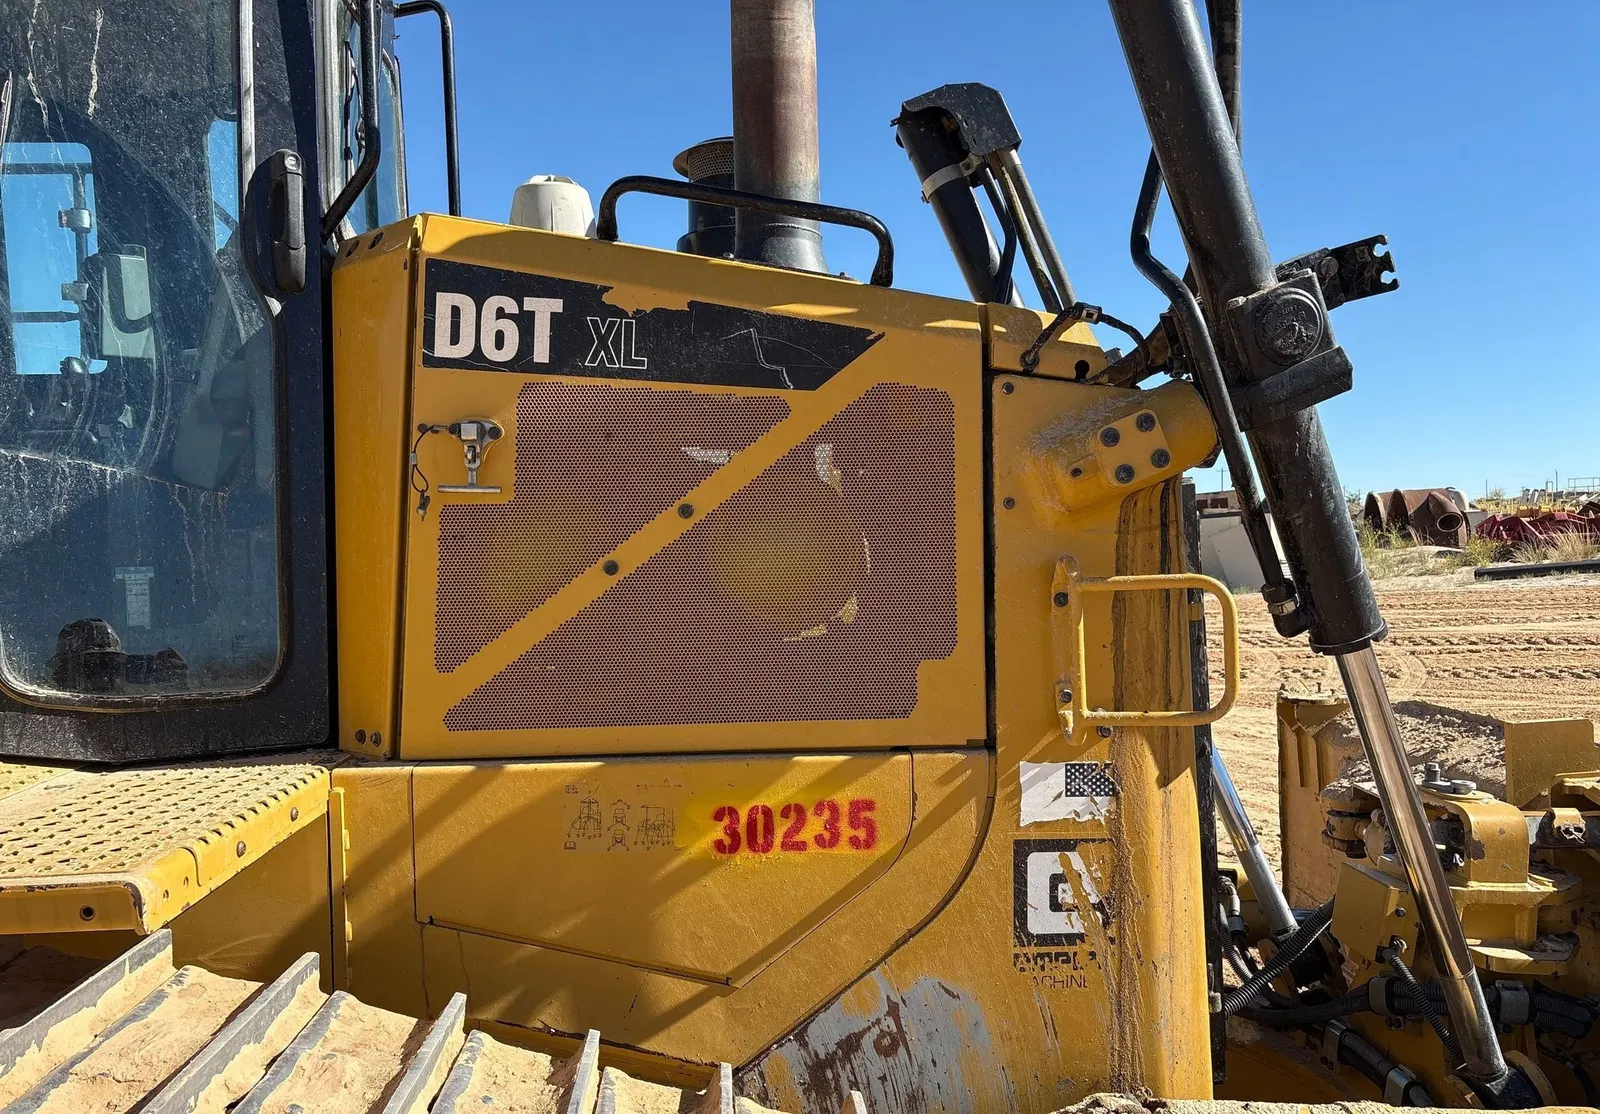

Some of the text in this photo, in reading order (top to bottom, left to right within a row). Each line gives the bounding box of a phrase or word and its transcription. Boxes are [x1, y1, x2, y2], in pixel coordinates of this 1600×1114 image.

[434, 291, 648, 370] D6T XL
[711, 799, 878, 856] 30235
